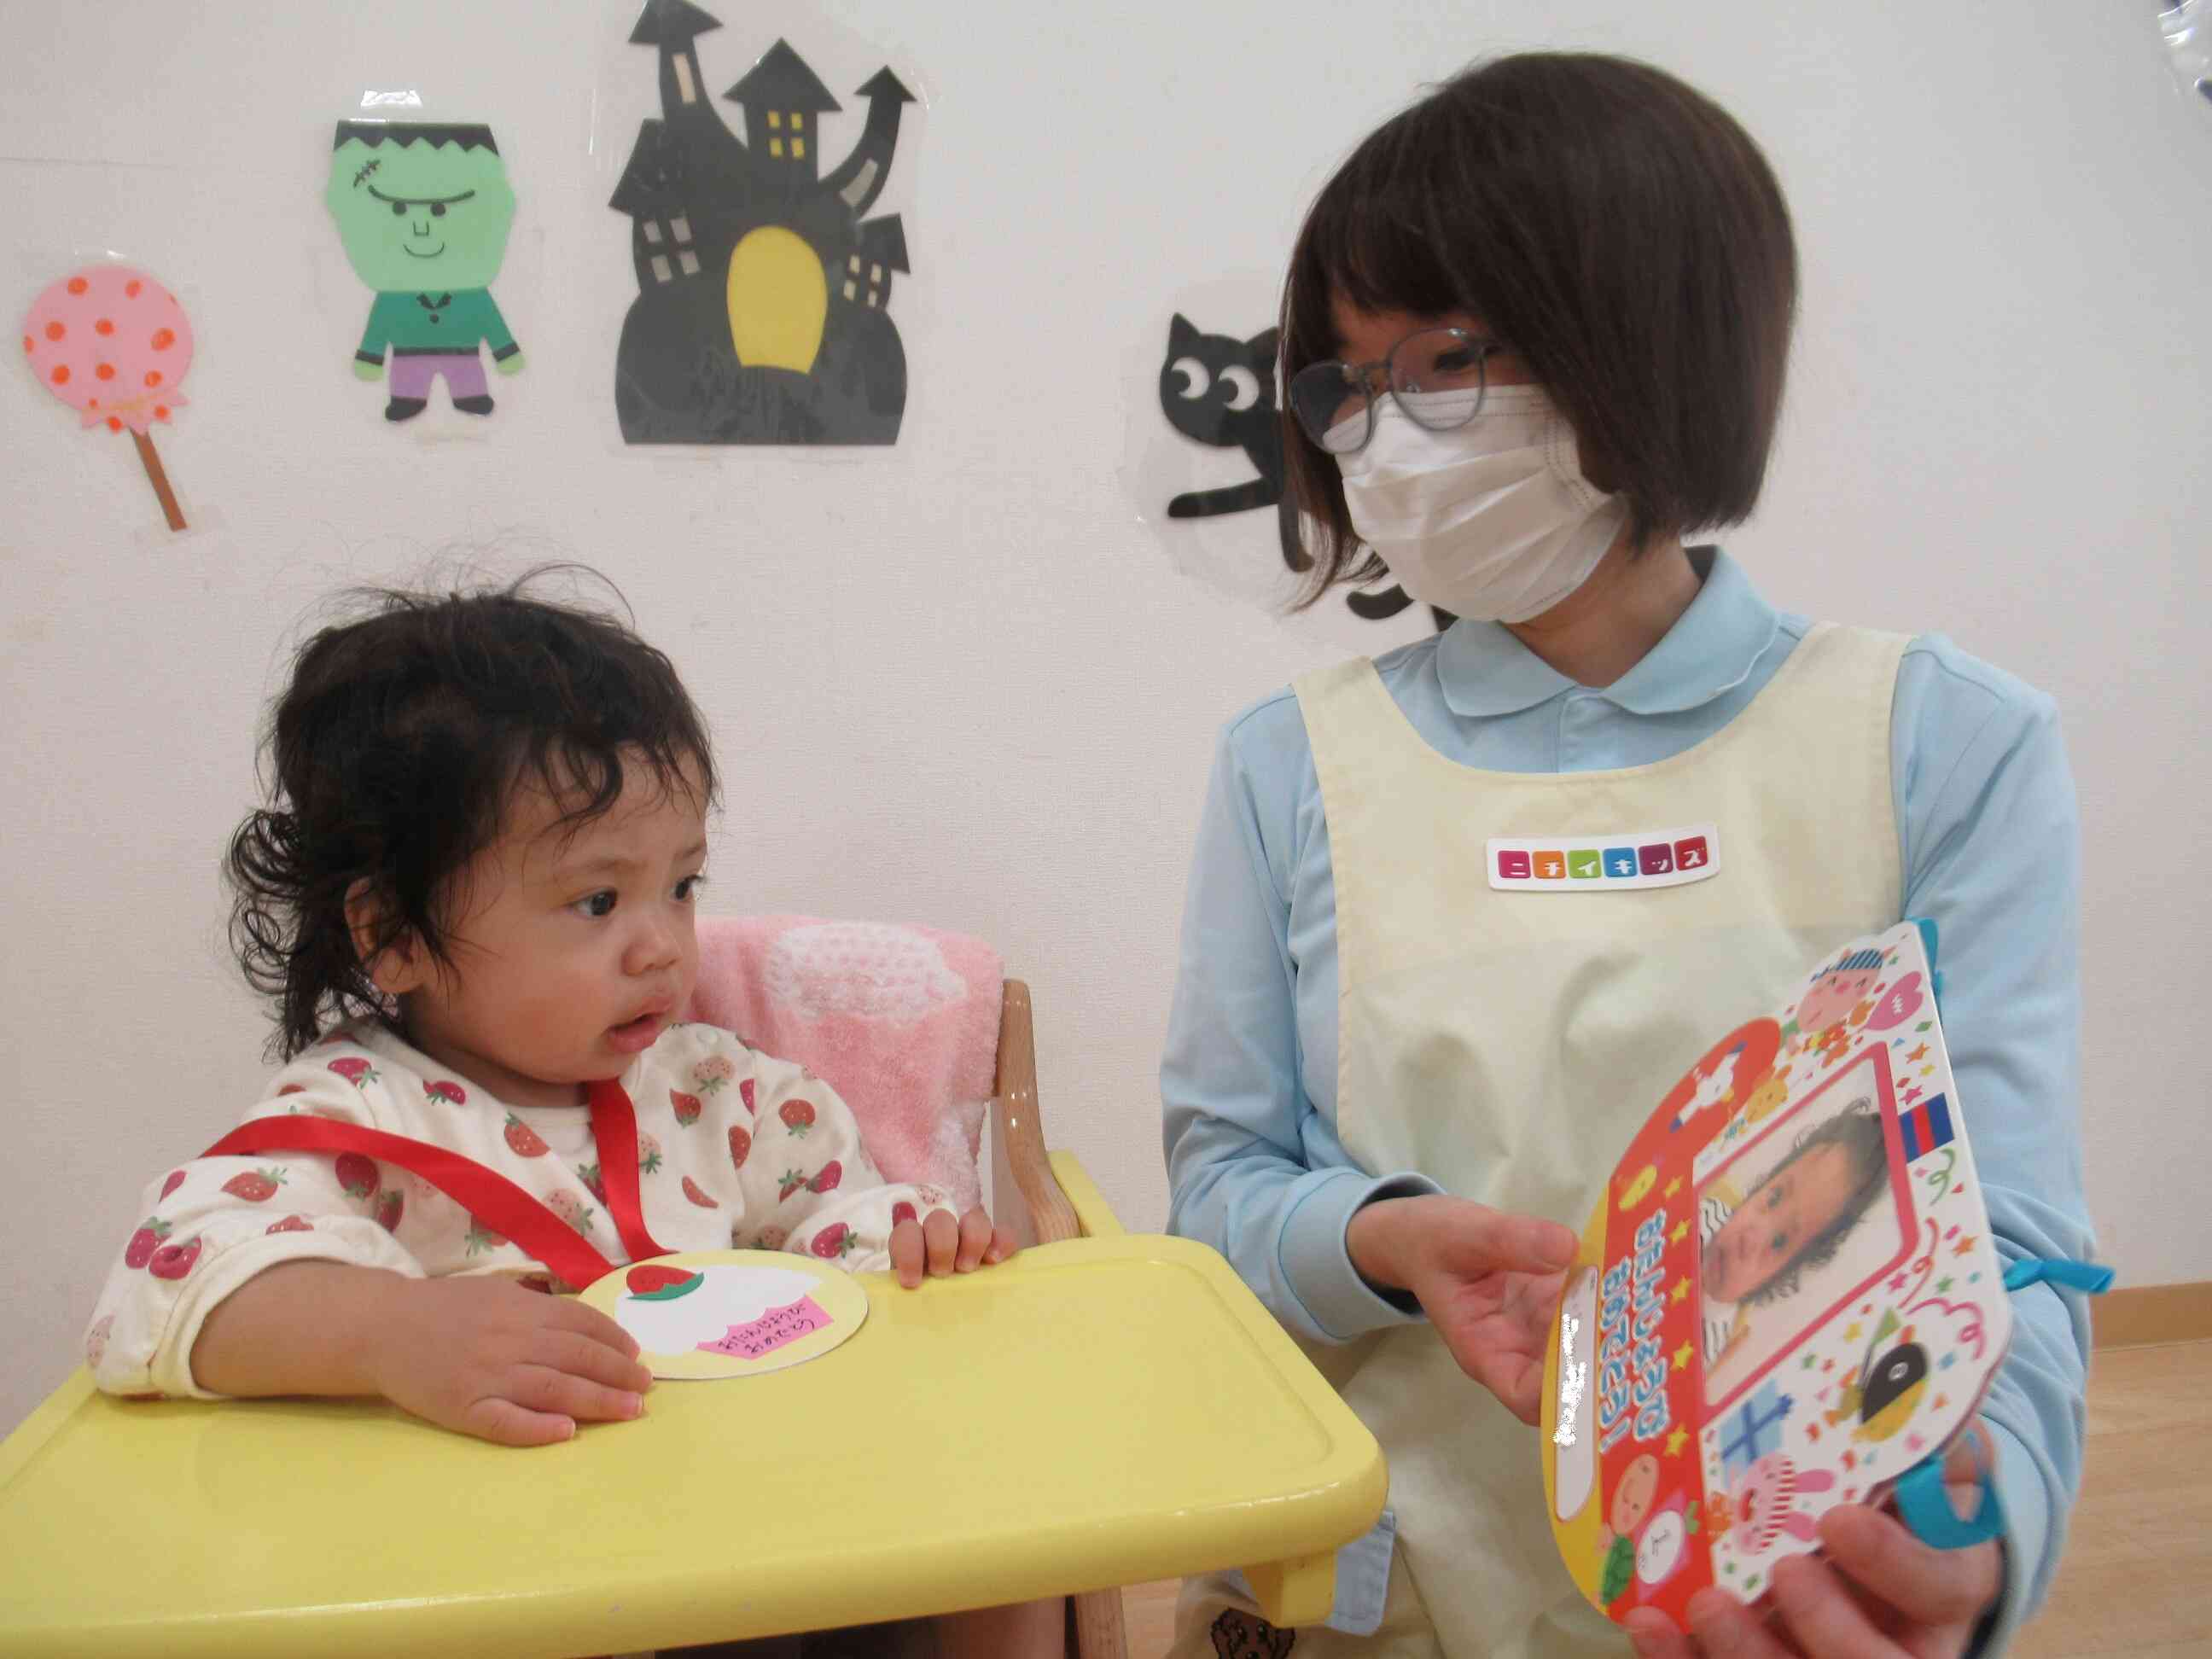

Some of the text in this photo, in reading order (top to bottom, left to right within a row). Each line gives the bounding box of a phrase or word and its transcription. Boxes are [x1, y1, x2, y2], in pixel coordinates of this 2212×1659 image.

[1510, 845, 1706, 876] ニチイキッズ
[1633, 1208, 1670, 1441] おたんじょうび
